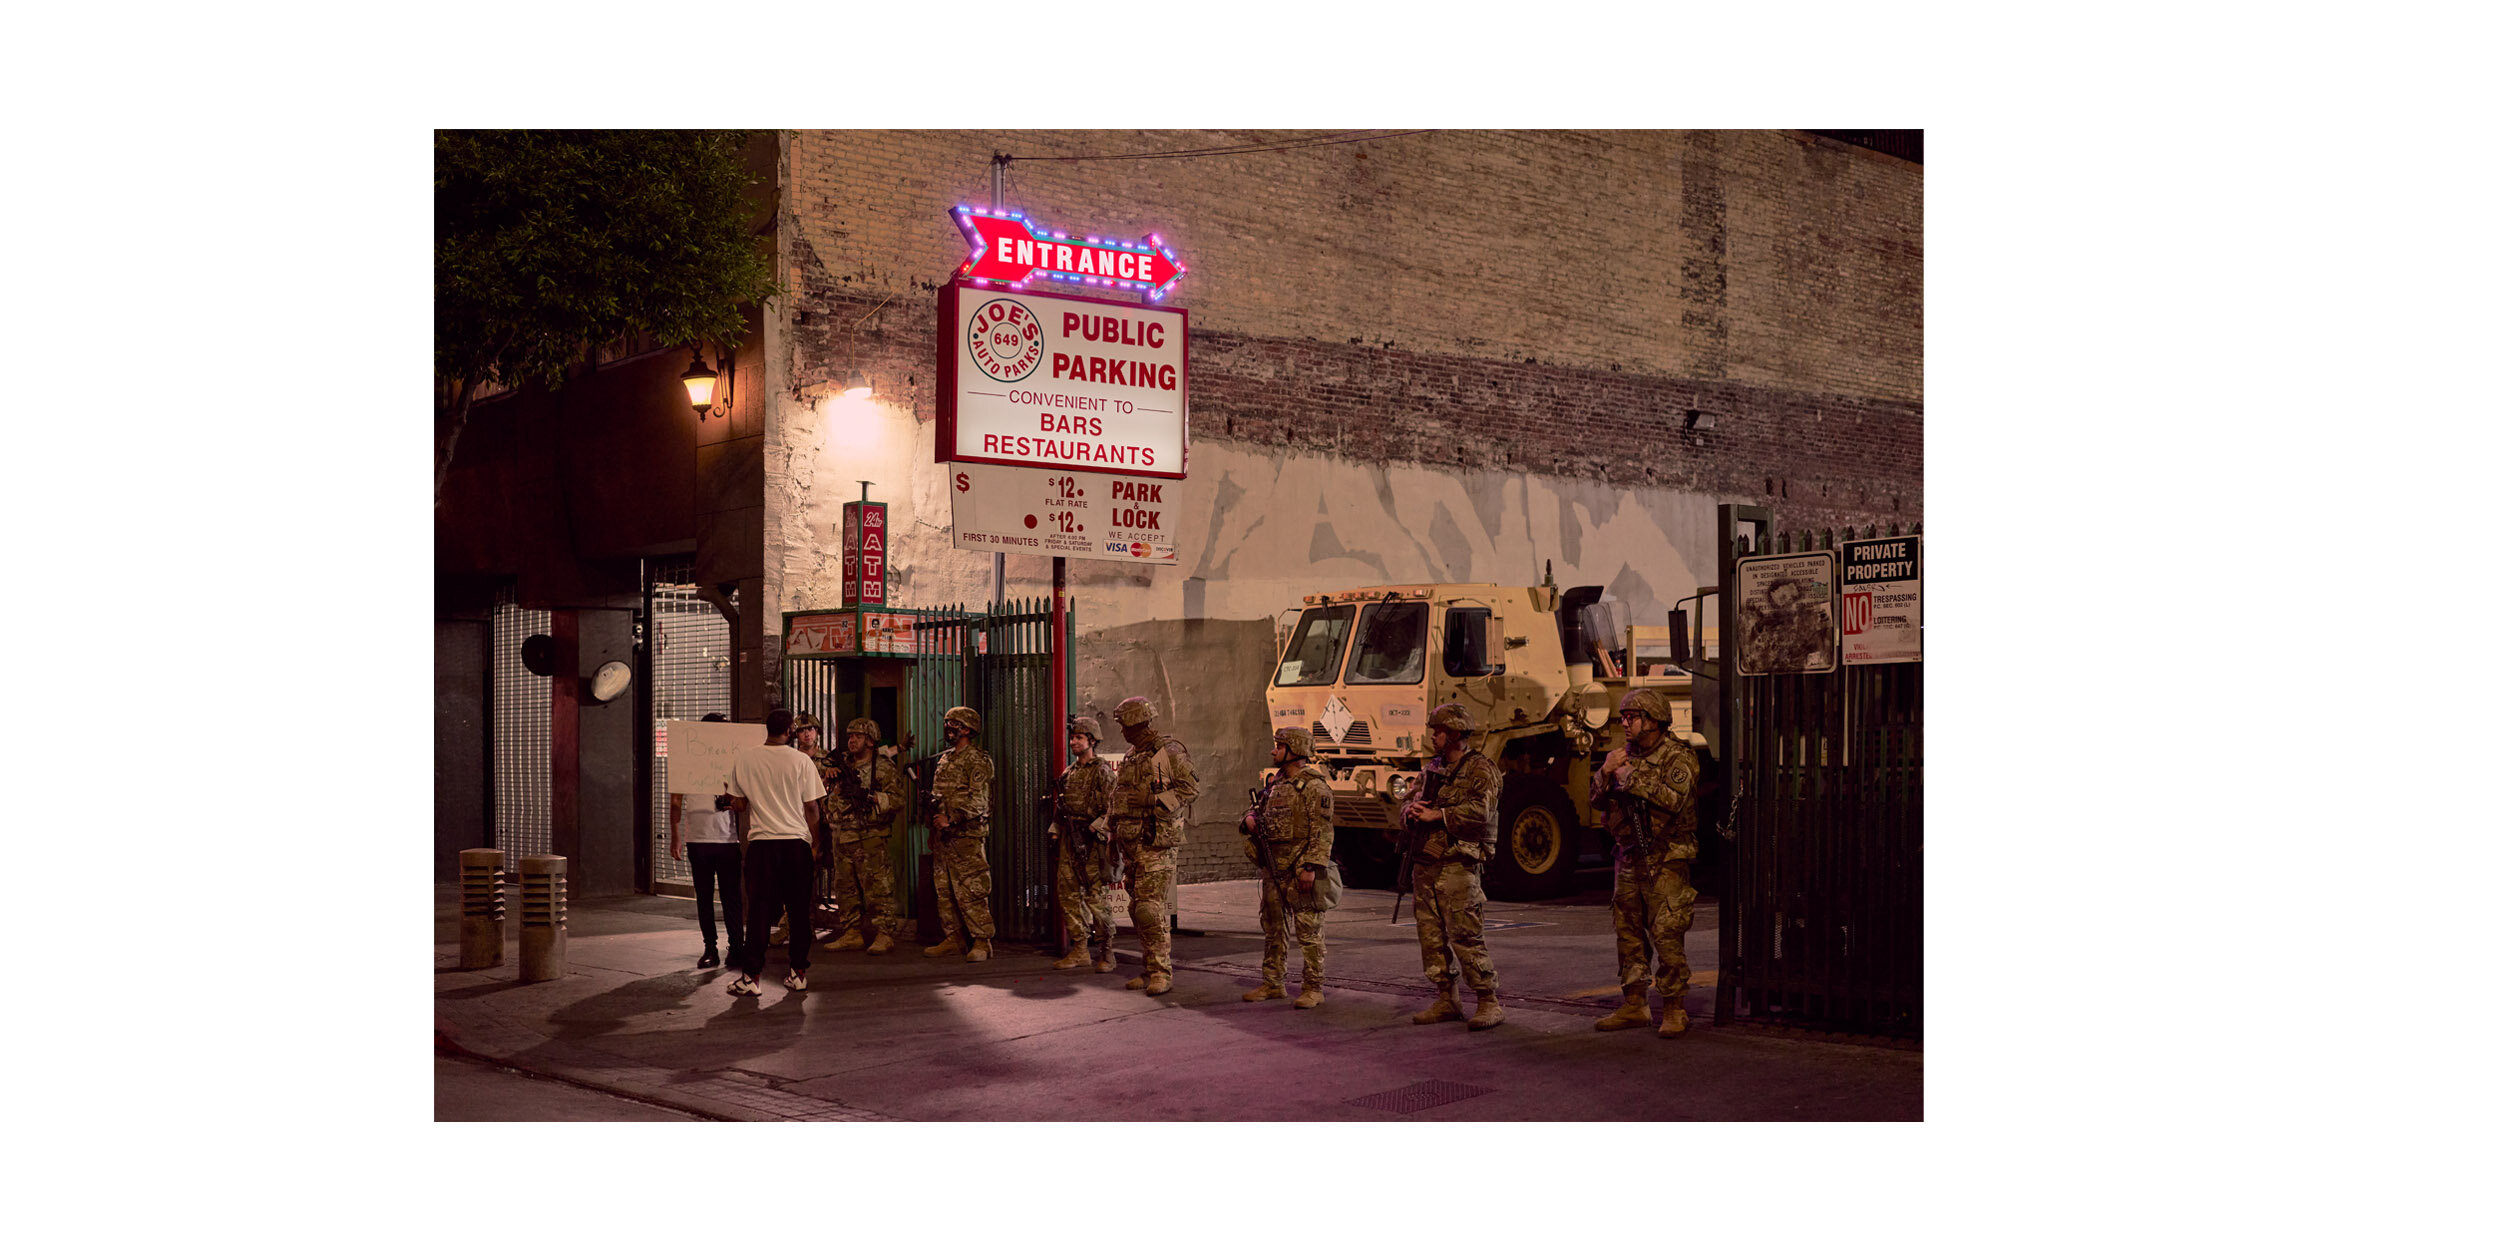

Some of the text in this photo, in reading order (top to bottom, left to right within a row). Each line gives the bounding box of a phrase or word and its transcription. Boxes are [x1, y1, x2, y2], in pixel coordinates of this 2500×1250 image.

[998, 237, 1152, 280] ENTRANCE
[977, 303, 1039, 341] JOE'S
[1063, 312, 1164, 349] PUBLIC
[994, 332, 1019, 347] 649
[972, 340, 1039, 377] AUTO PARKS
[1052, 352, 1176, 391] PARKING
[1009, 390, 1133, 414] CONVENIENT TO
[1040, 413, 1102, 436] BARS
[984, 434, 1155, 466] RESTAURANTS
[956, 472, 970, 493] $
[1112, 480, 1163, 504] PARK
[1045, 498, 1088, 508] FLAT RATE
[1133, 502, 1139, 510] &
[1112, 507, 1160, 530] LOCK
[963, 532, 1039, 547] FIRST 30 MINUTES
[1105, 542, 1128, 552] VISA
[1108, 531, 1165, 542] WE ACCEPT
[1854, 542, 1906, 562] PRIVATE
[844, 534, 857, 598] ATM
[863, 533, 883, 598] ATM
[1746, 563, 1780, 572] UNAUTHORIZED
[1783, 561, 1805, 569] VEHICLES
[1791, 568, 1819, 576] ACCESSIBLE
[1847, 561, 1913, 580] PROPERTY
[1873, 593, 1917, 603] TRESPASSING
[1845, 595, 1870, 632] NO
[1873, 615, 1907, 625] LOITERING
[682, 727, 741, 757] Break
